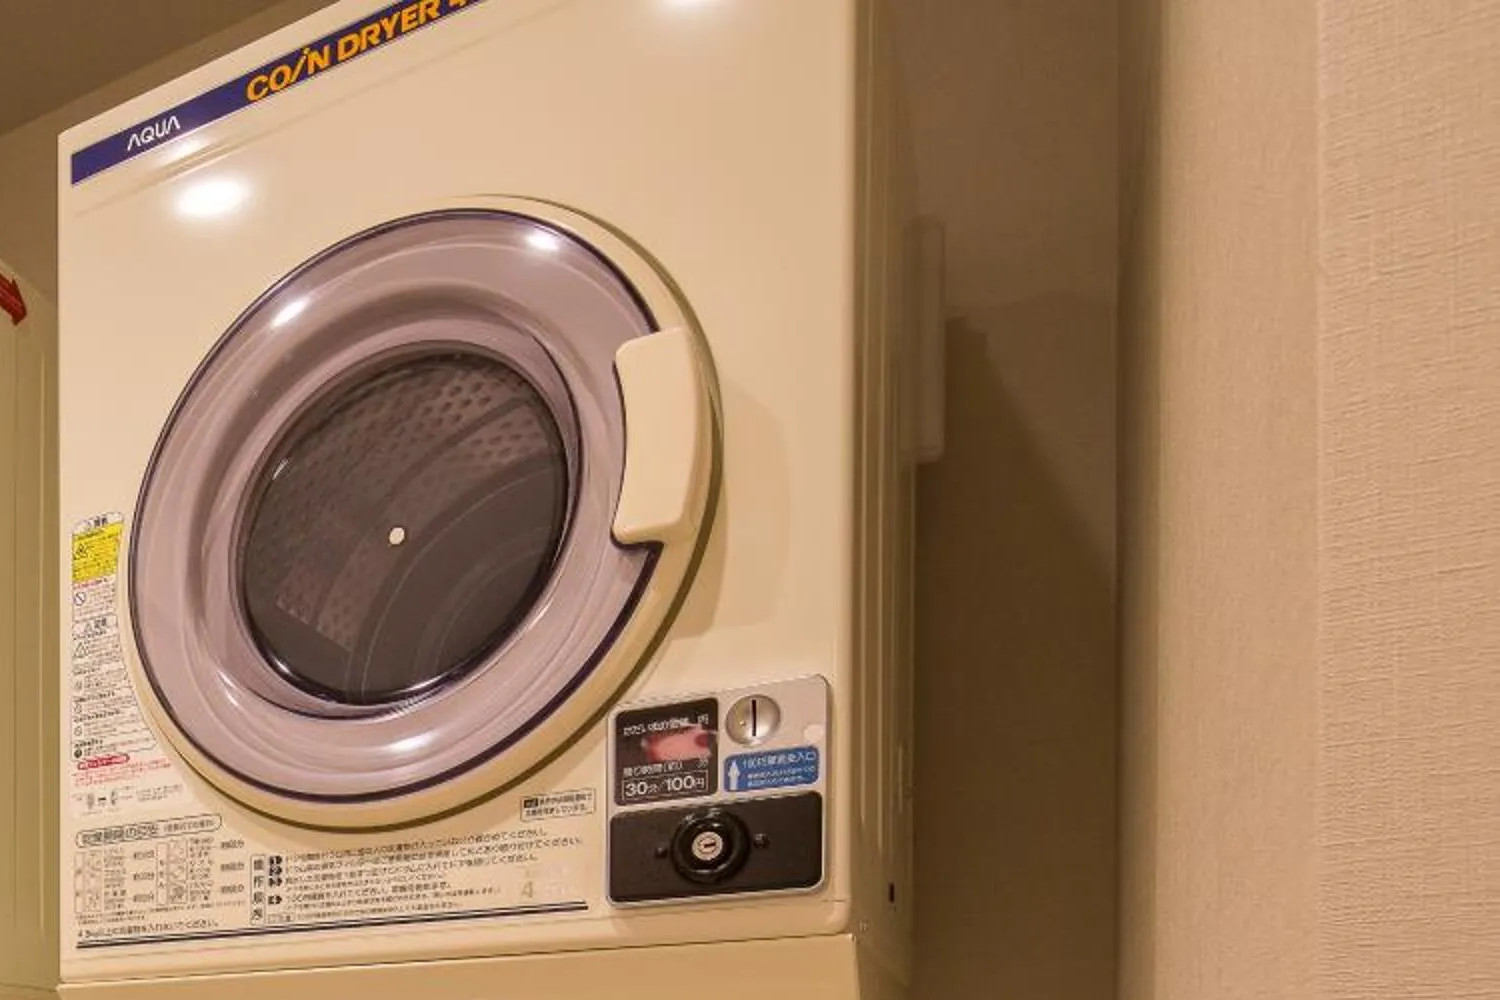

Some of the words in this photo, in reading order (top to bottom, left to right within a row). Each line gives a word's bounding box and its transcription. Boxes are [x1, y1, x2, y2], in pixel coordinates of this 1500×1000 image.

[246, 48, 328, 102] COIN
[337, 0, 440, 62] DRYER
[127, 116, 181, 151] AQUA
